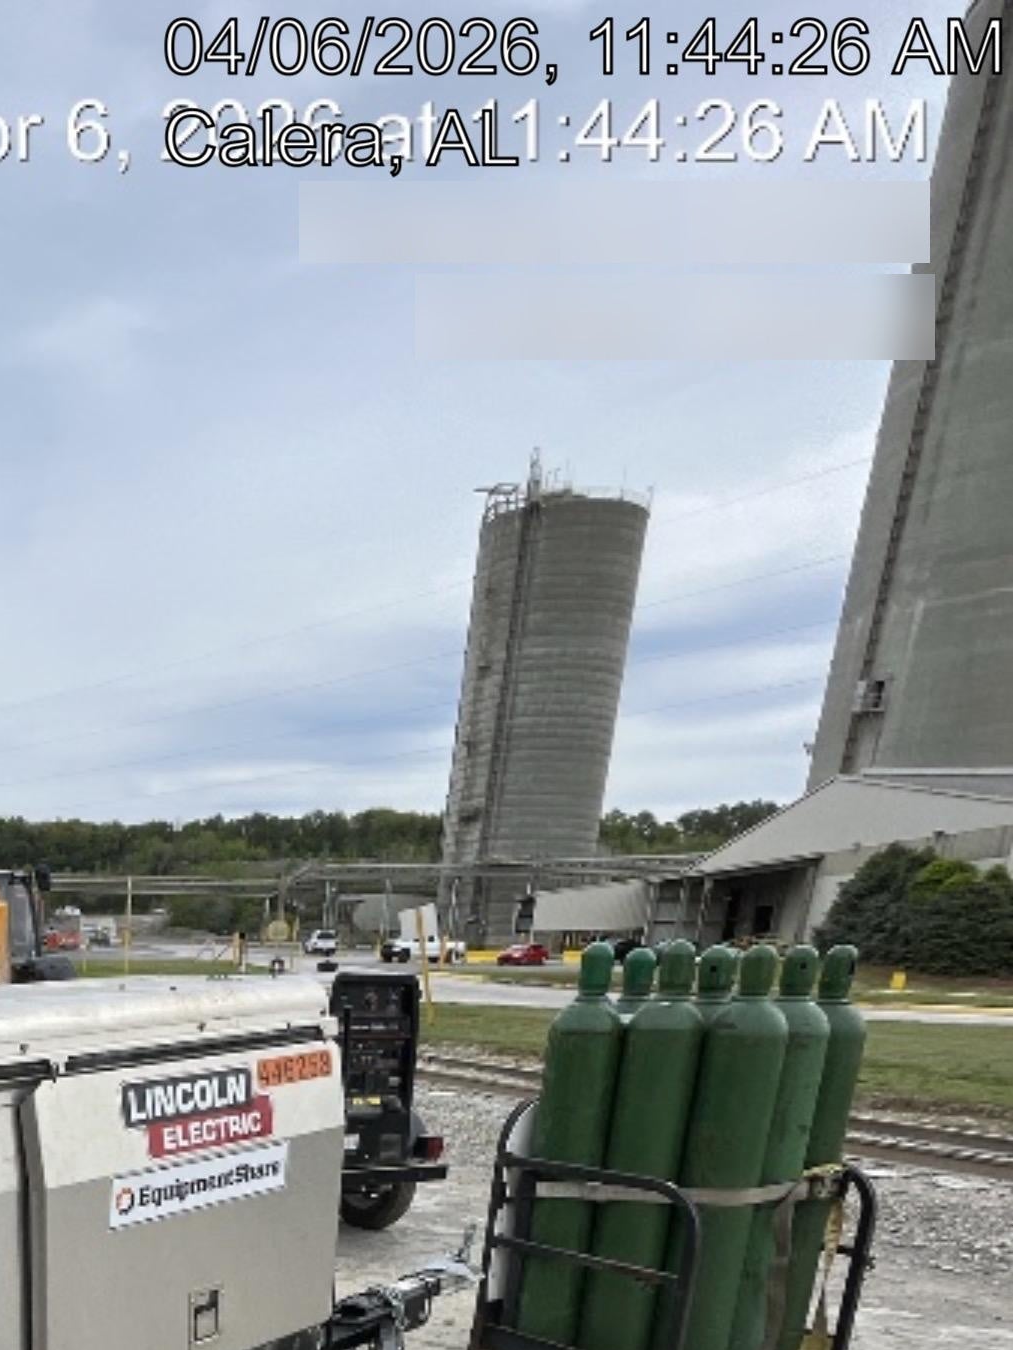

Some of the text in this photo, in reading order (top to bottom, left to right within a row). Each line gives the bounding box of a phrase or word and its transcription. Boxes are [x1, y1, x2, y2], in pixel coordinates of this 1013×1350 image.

[127, 1072, 246, 1122] LINCOLN
[162, 1111, 262, 1150] ELECTRIC
[138, 1160, 280, 1207] EquipmentShare
